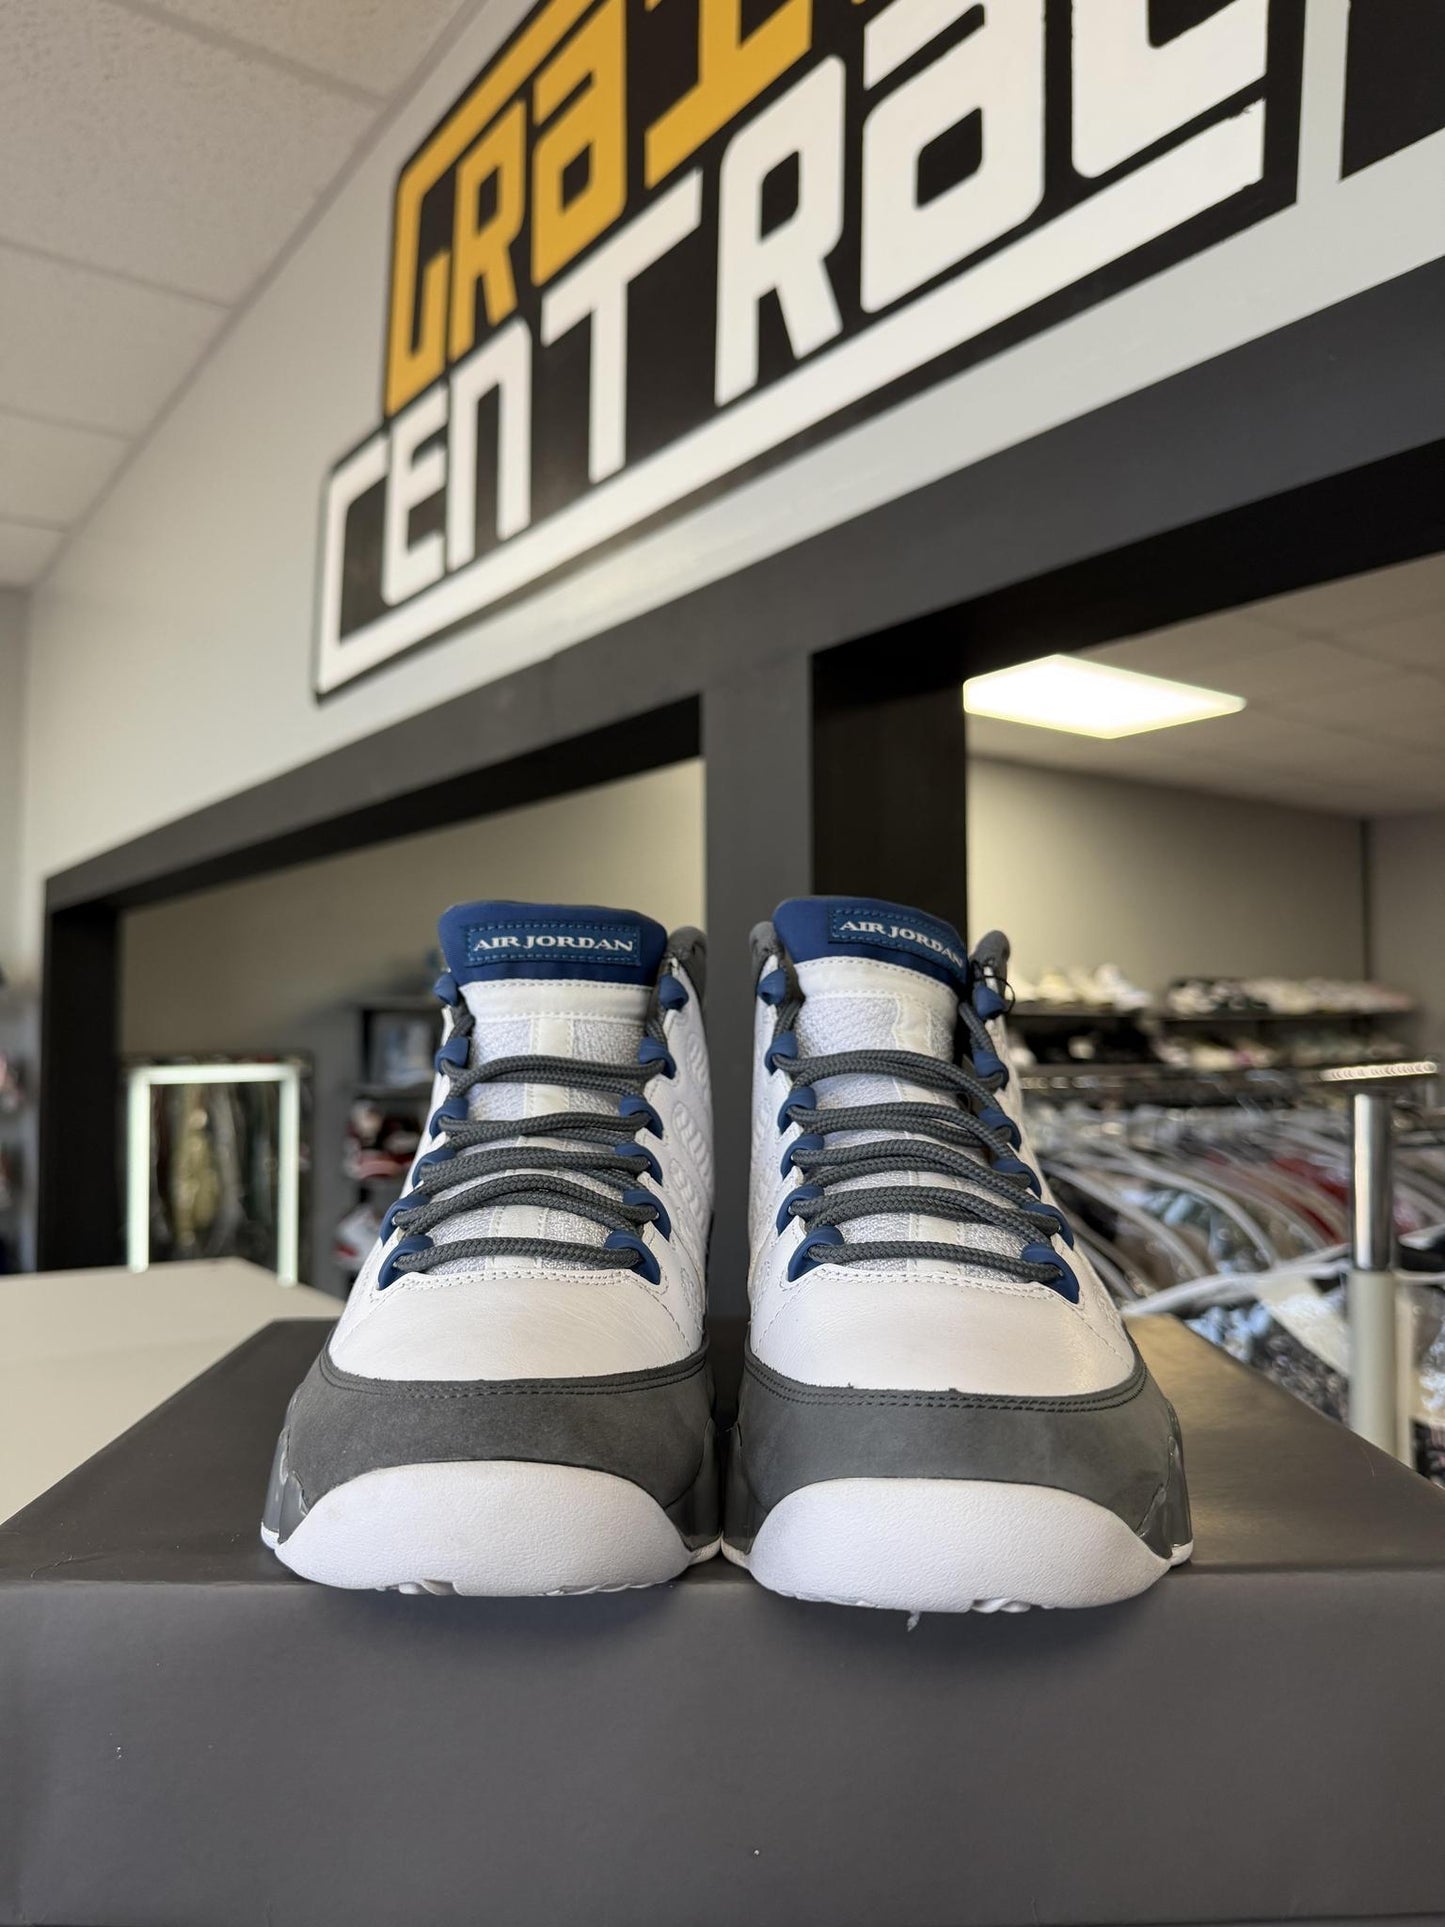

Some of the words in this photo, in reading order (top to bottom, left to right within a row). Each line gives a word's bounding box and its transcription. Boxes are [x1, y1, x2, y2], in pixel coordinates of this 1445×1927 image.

[384, 0, 868, 418] GRaI
[473, 935, 521, 951] AIR
[522, 935, 634, 952] JORDAN
[839, 920, 887, 935] AIR
[887, 925, 964, 968] JORDAN
